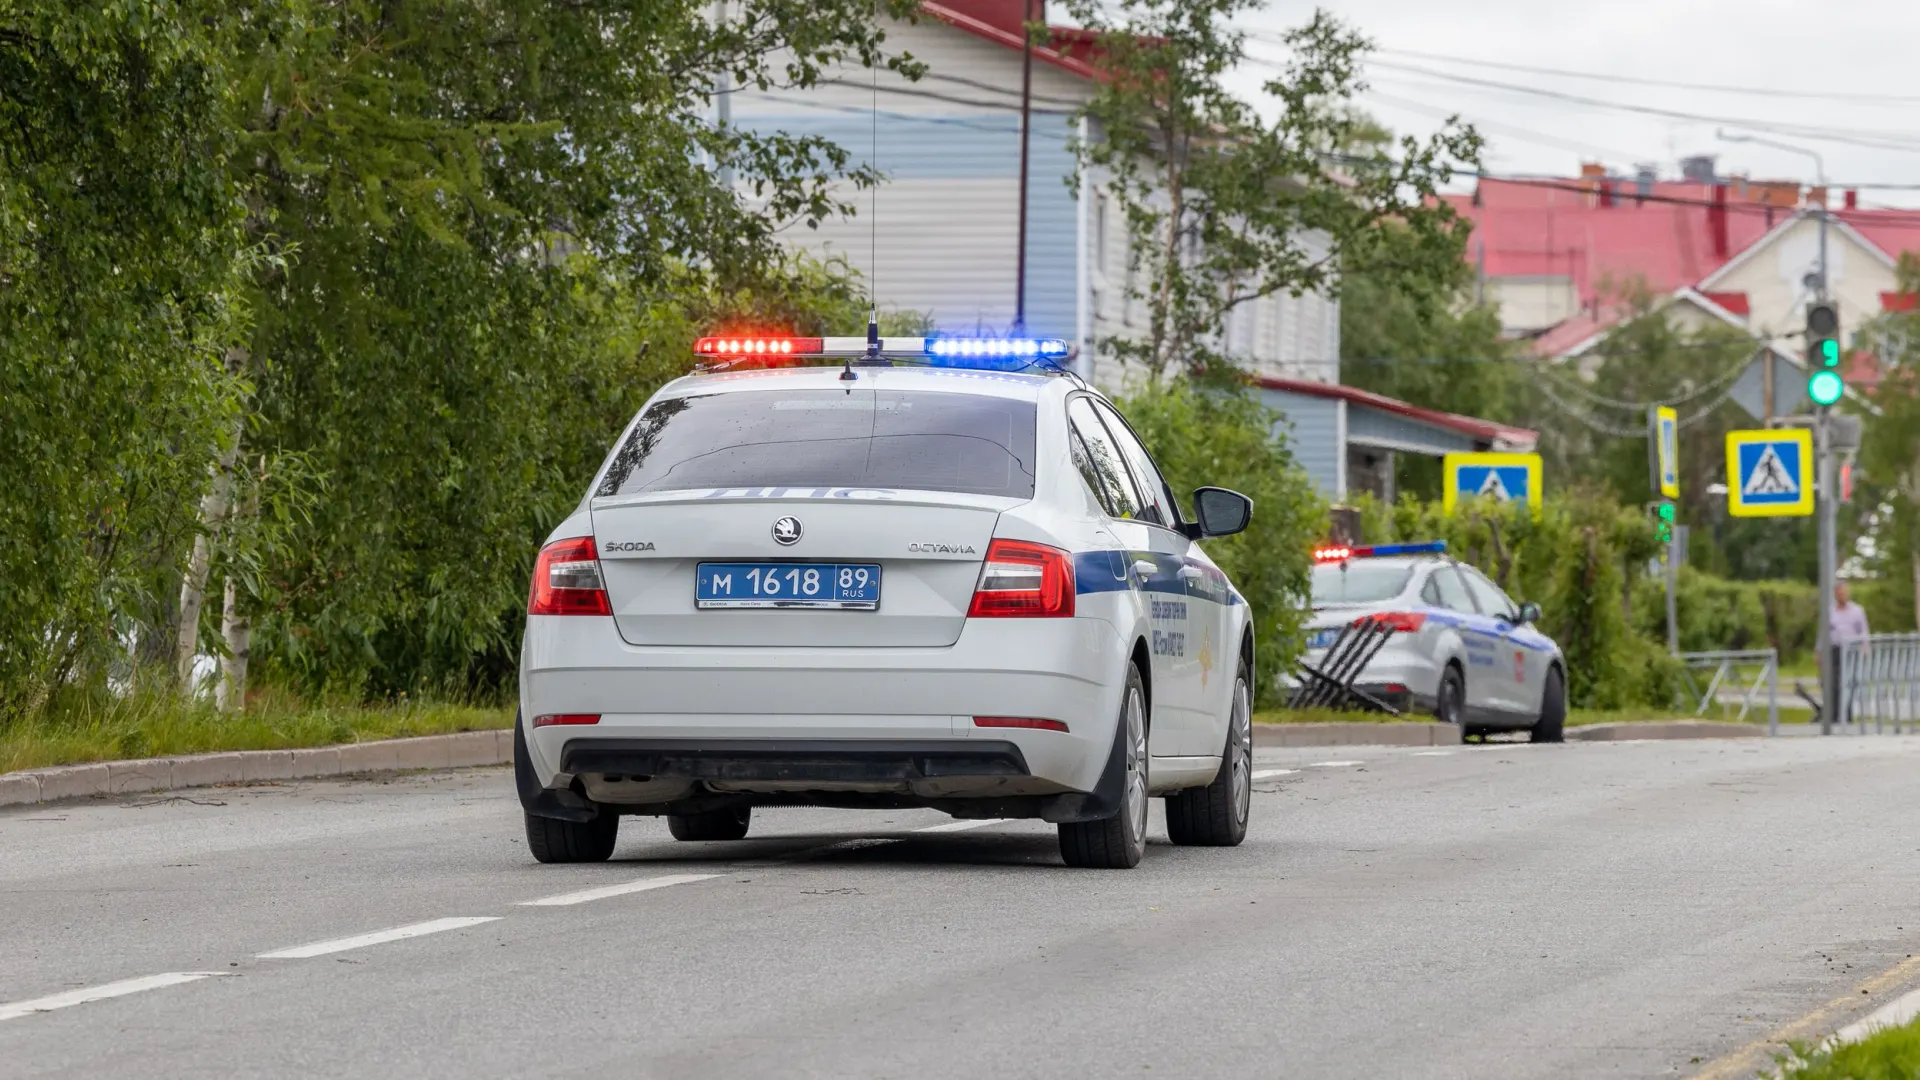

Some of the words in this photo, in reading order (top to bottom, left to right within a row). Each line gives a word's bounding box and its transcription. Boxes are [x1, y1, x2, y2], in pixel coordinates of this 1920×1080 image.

[907, 542, 976, 554] OCTAVIA
[746, 568, 820, 595] 1618
[839, 568, 869, 589] 89
[842, 590, 864, 598] RUS
